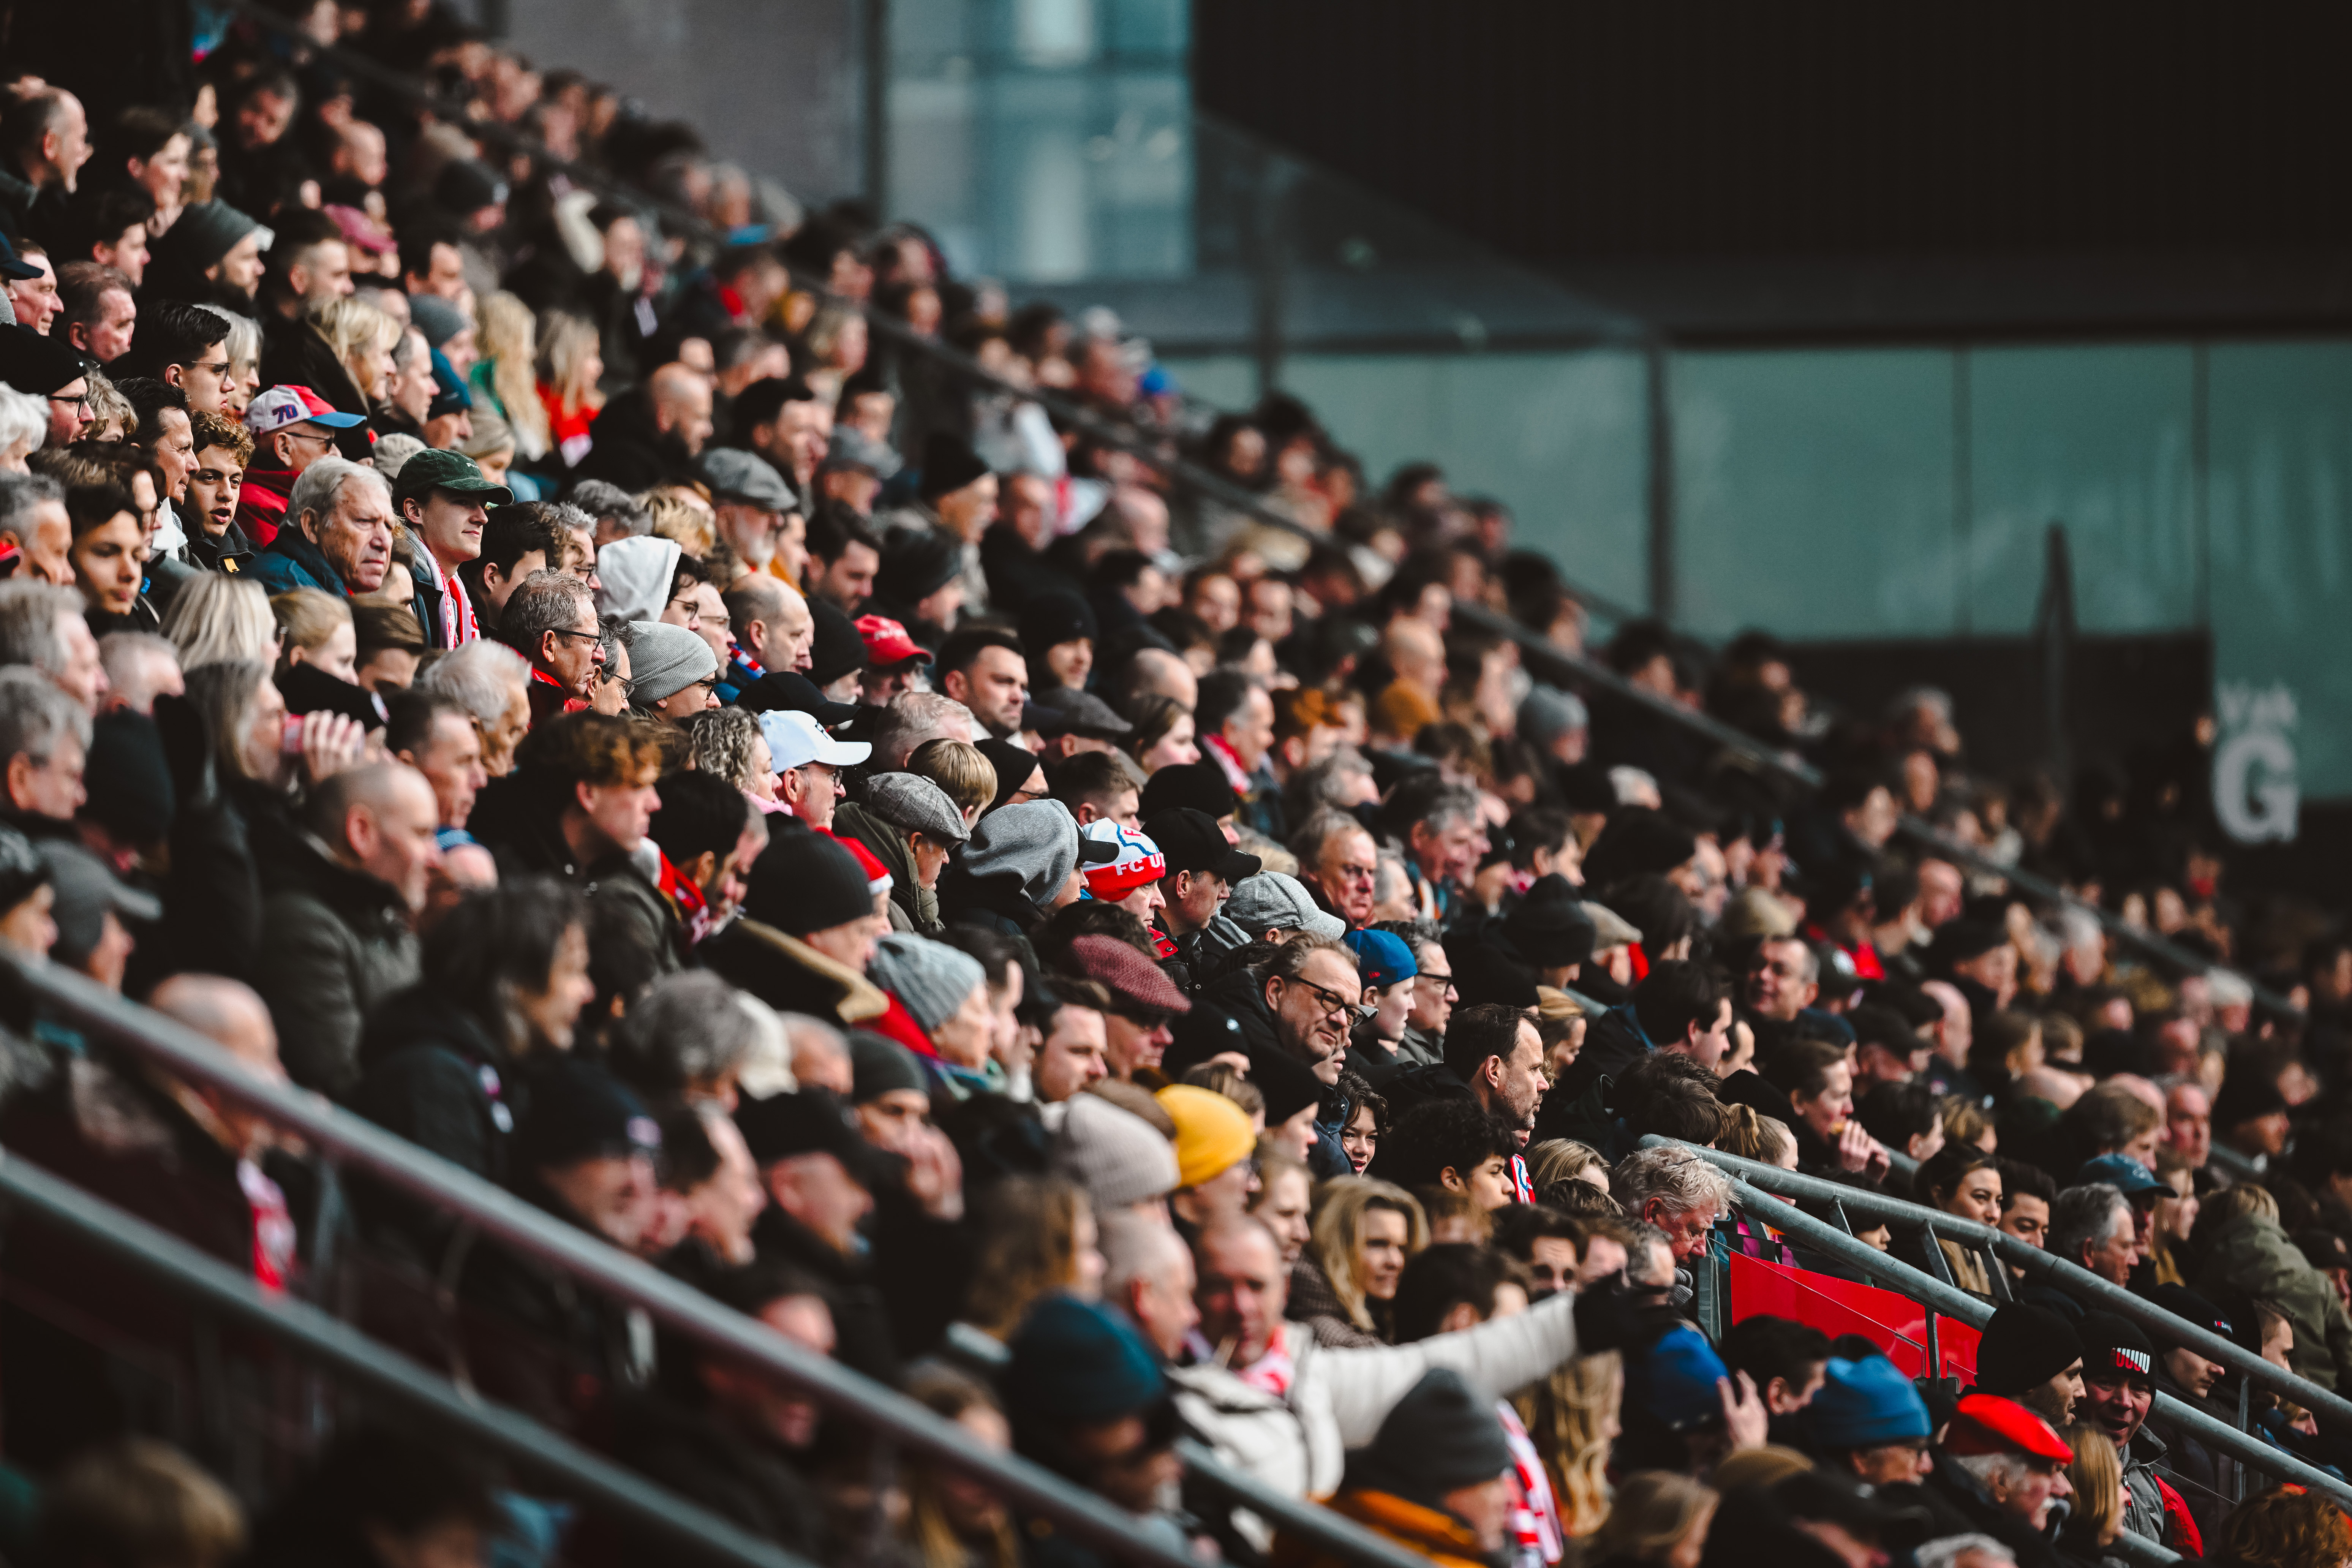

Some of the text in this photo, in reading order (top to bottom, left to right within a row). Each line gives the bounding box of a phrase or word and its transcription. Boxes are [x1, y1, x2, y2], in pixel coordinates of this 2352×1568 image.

[272, 404, 298, 424] 70
[2213, 733, 2300, 845] G
[1116, 859, 1144, 876] FC
